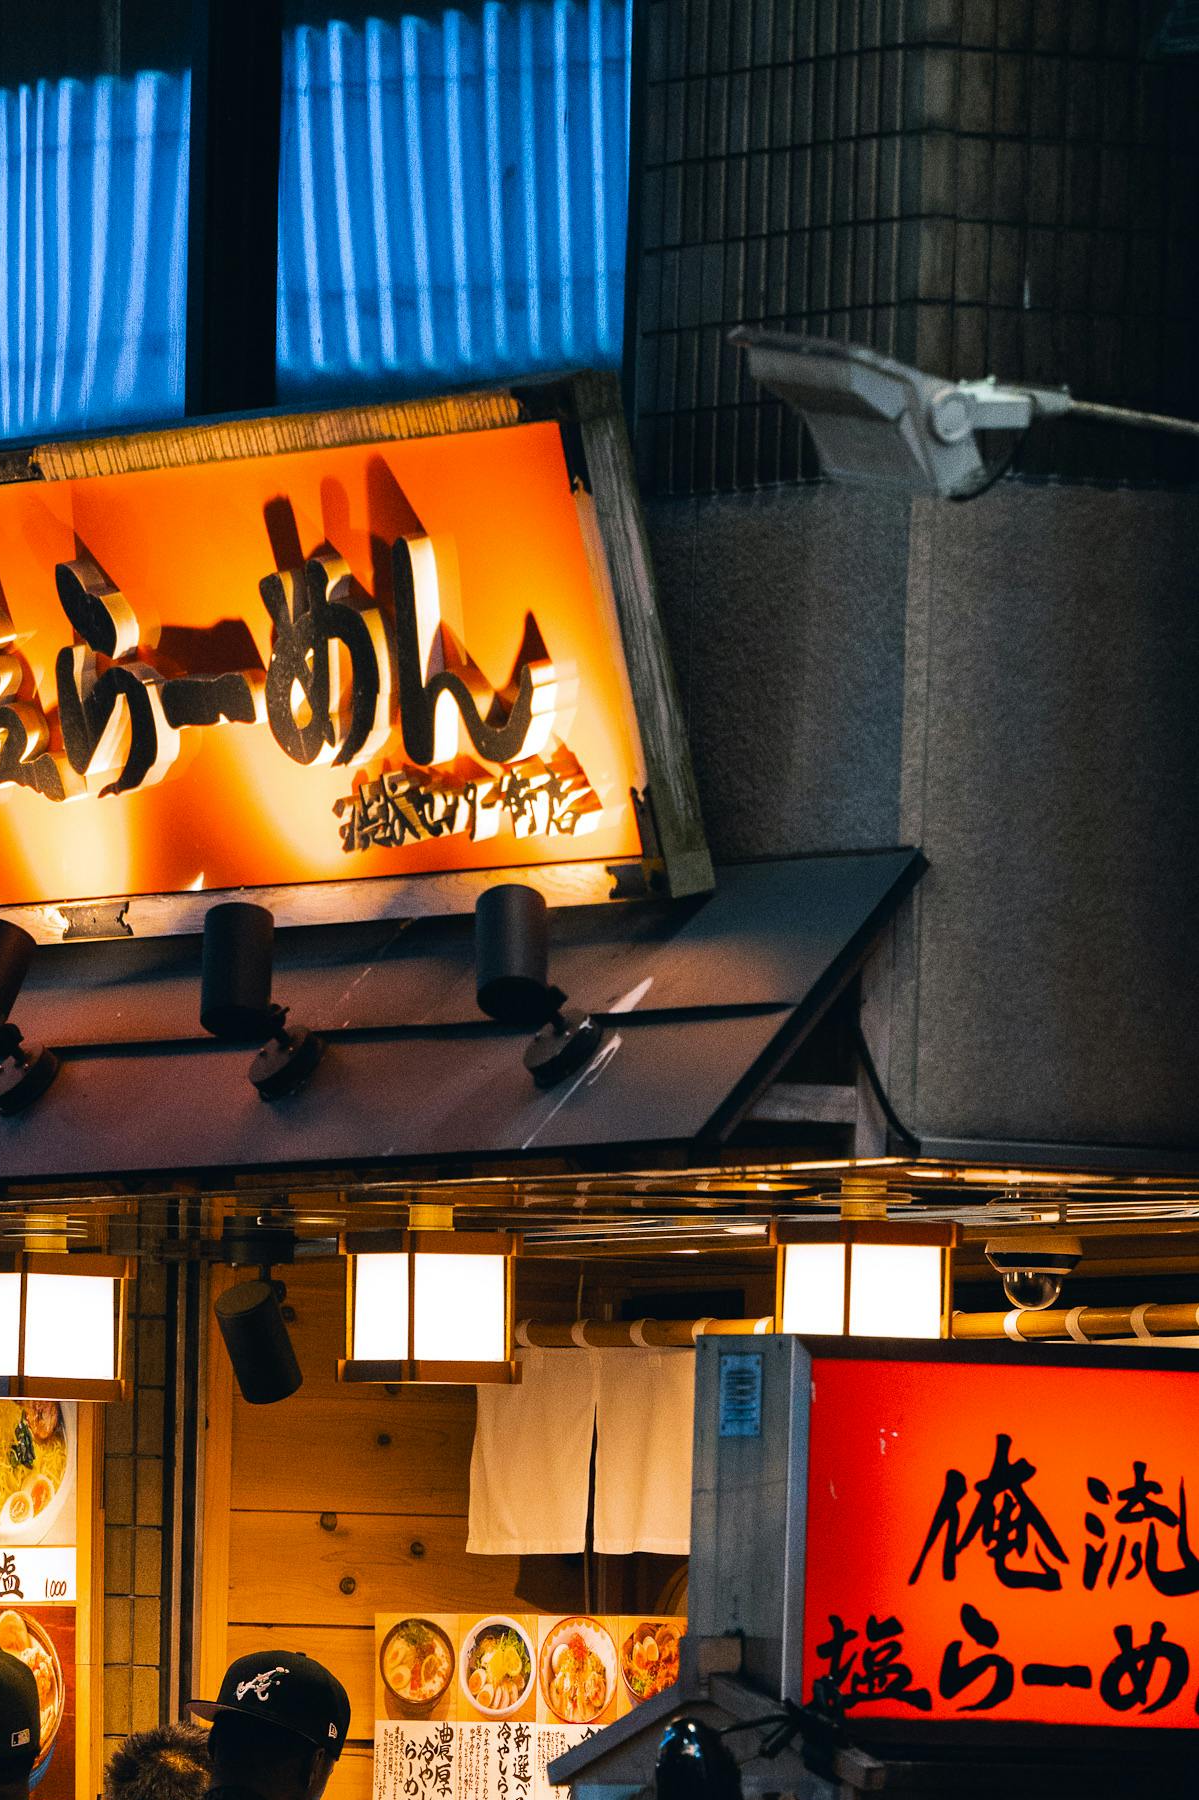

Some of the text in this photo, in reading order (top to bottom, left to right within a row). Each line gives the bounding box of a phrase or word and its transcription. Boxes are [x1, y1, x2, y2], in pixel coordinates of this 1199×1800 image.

[907, 1433, 1199, 1598] 俺流
[814, 1602, 1199, 1715] 塩らーめ
[432, 1722, 454, 1798] 濃厚
